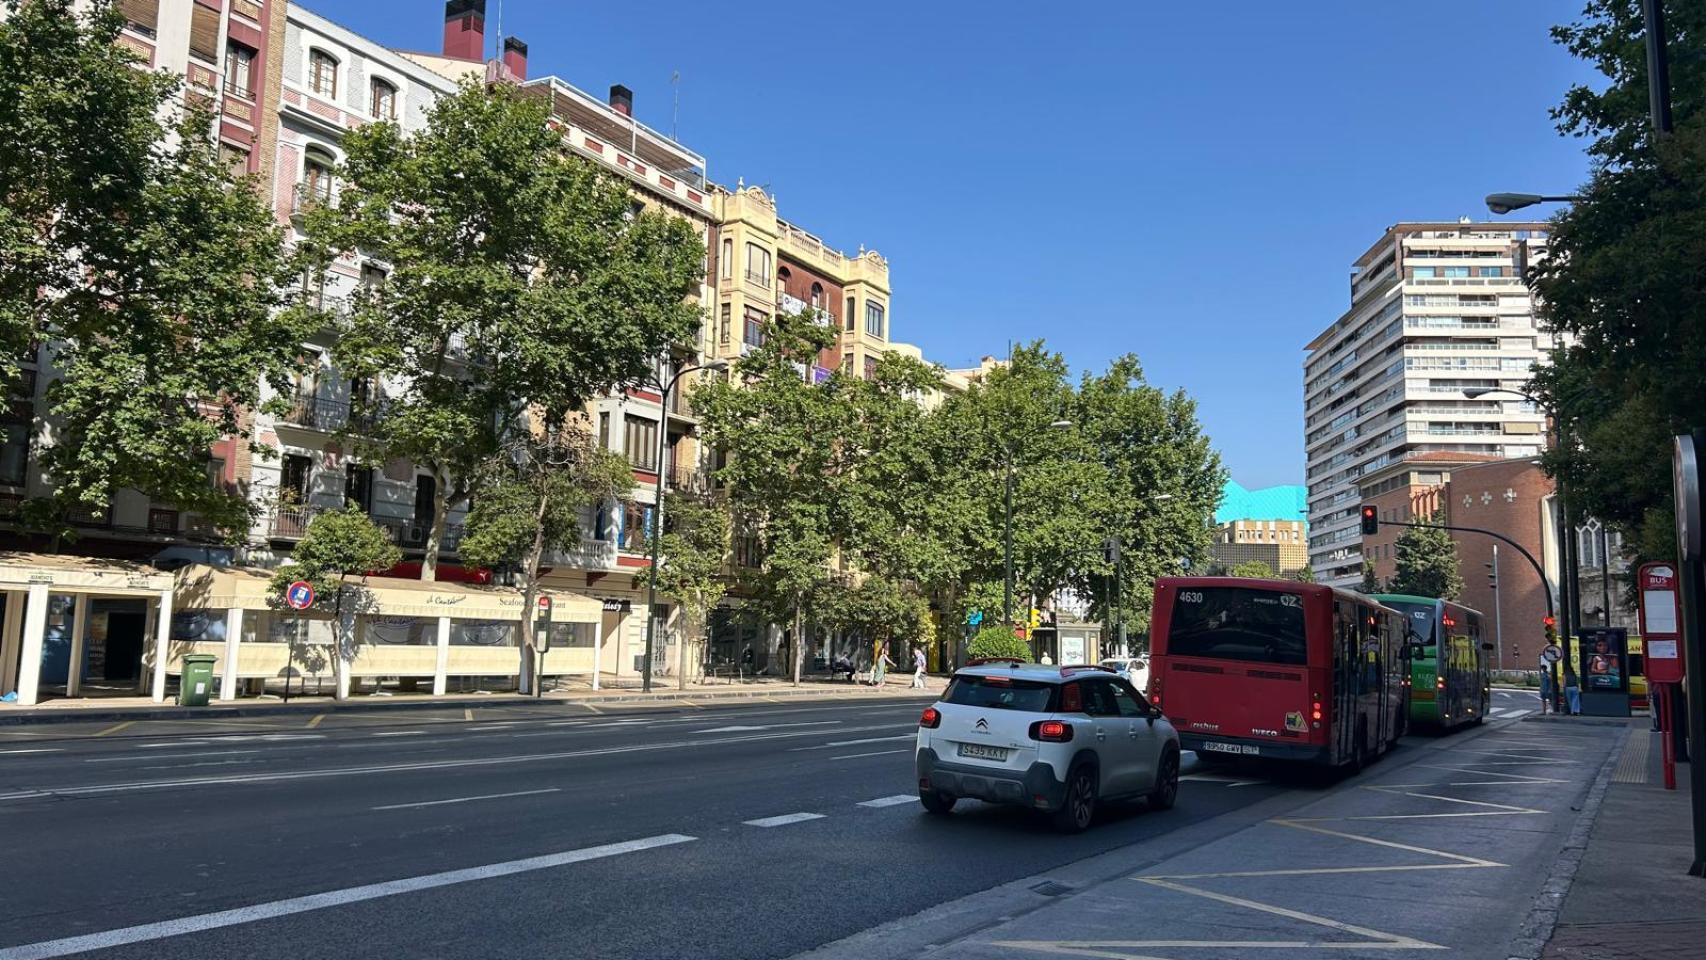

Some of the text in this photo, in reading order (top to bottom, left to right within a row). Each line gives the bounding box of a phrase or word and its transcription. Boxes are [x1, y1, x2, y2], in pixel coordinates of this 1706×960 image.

[1179, 591, 1203, 603] 4630
[499, 598, 525, 607] Seafoo
[1251, 728, 1278, 737] IVECO
